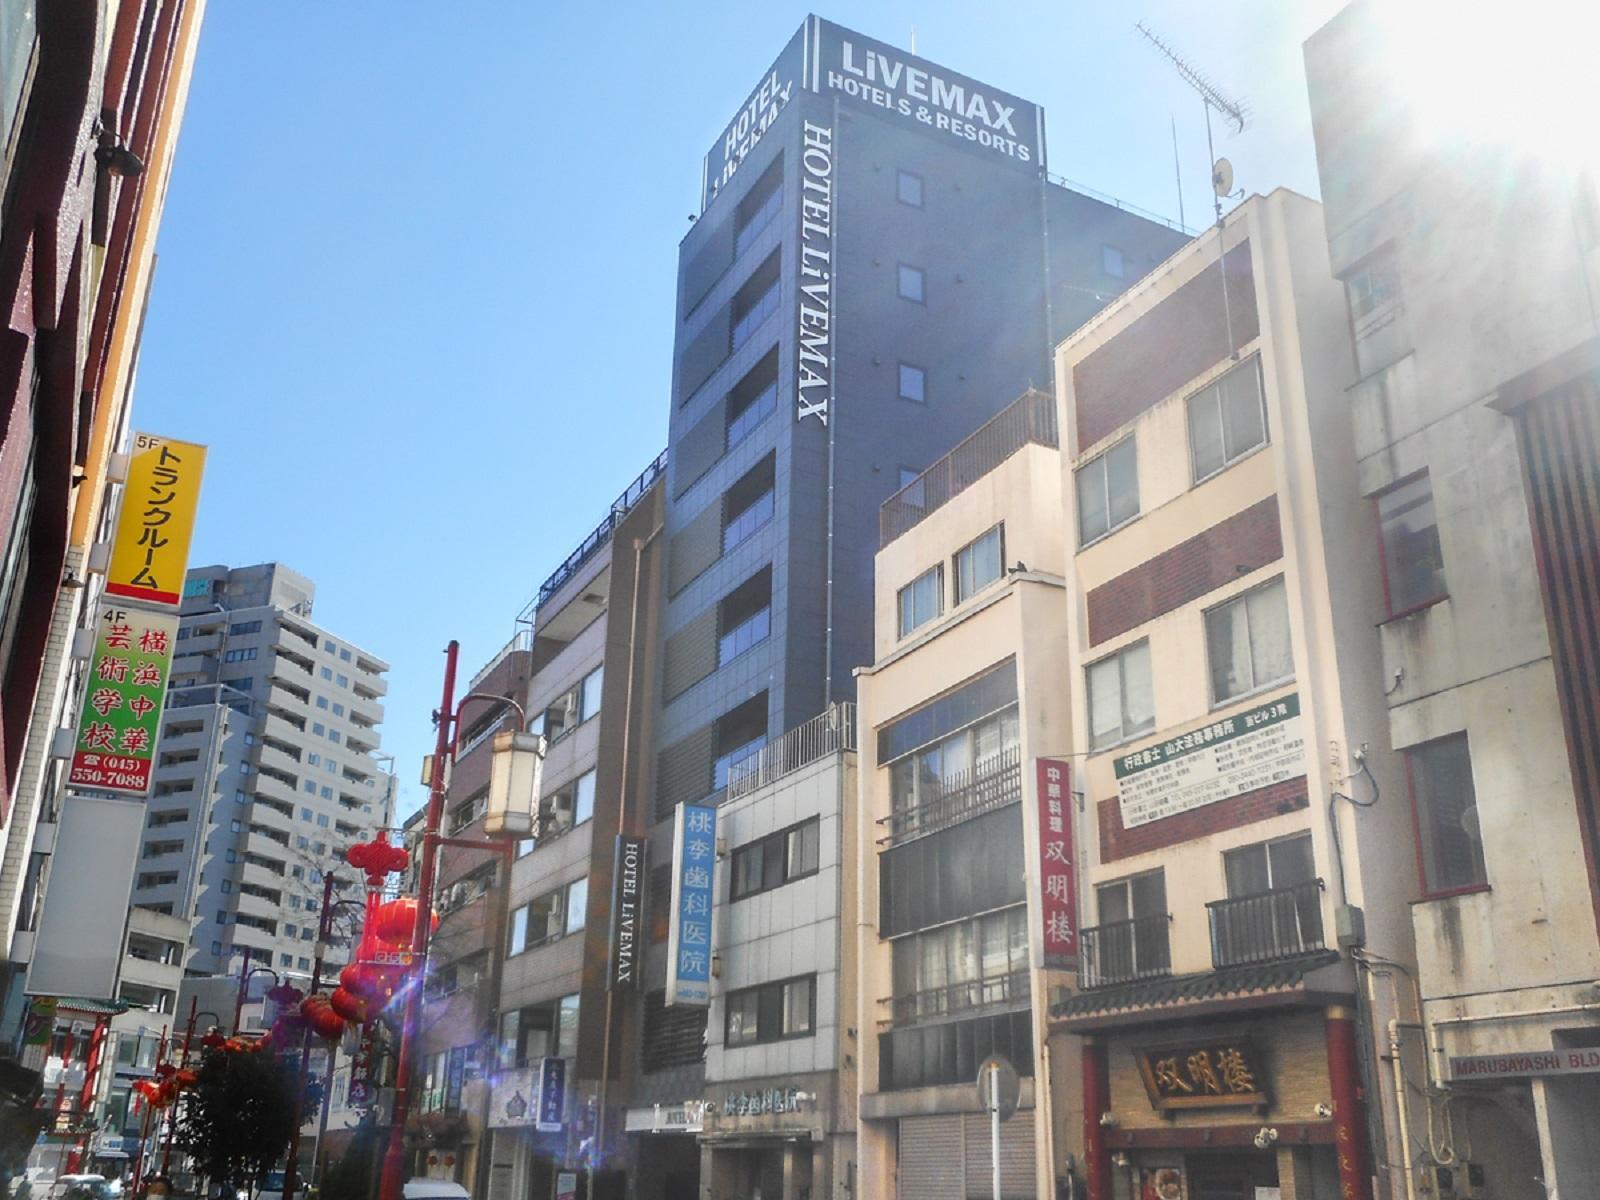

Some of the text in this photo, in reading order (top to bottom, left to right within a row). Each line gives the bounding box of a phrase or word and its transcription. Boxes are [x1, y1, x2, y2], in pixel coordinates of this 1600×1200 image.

[725, 70, 780, 161] HOTEL
[828, 71, 1031, 162] HOTELS & RESORTS
[842, 40, 1017, 137] LiVEMAX
[798, 119, 832, 426] HOTEL LiVEMAX
[136, 435, 158, 449] 5F
[129, 446, 181, 590] トランクルーム
[103, 609, 125, 624] 4F
[80, 624, 134, 753] 芸術学校
[119, 628, 170, 755] 横浜中華
[72, 767, 145, 788] 550-7088
[103, 756, 140, 771] (045)
[617, 843, 638, 984] HOTEL LiVEMAX
[680, 811, 713, 975] 桃李歯科医院
[1044, 840, 1073, 945] 双明楼
[1455, 1054, 1561, 1075] MARUBAYASHI
